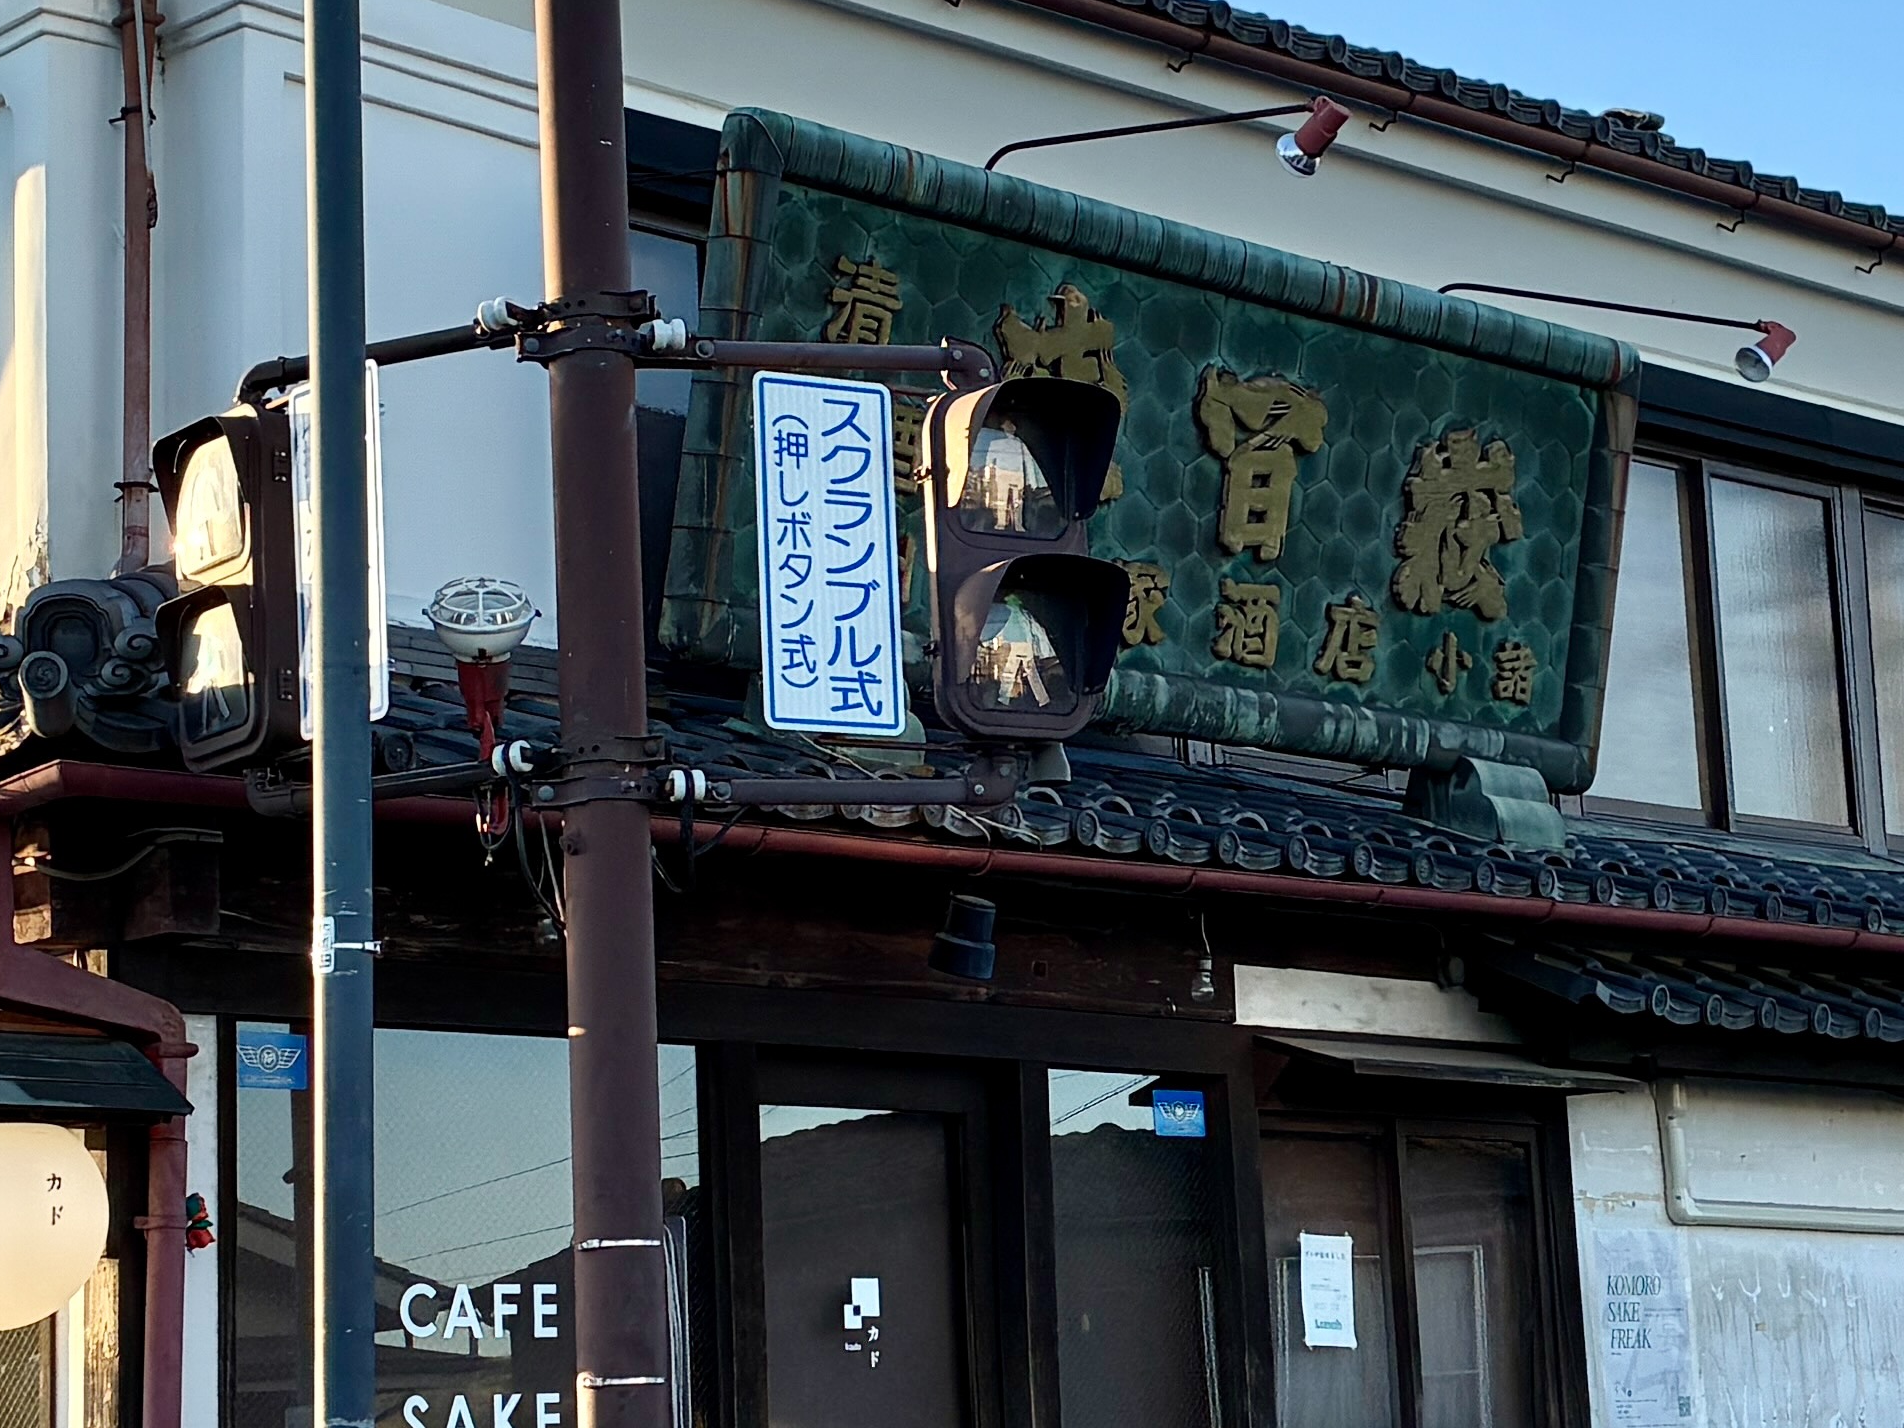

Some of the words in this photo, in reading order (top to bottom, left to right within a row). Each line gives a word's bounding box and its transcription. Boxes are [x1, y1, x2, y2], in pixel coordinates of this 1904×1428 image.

[770, 414, 818, 690] （押しボタン式）
[817, 395, 885, 719] スクランブル式
[46, 1171, 65, 1227] カド
[399, 1281, 558, 1339] CAFE
[1607, 1275, 1662, 1296] KOMORO
[1607, 1301, 1641, 1323] SAKE
[867, 1325, 880, 1368] カド
[1610, 1328, 1652, 1350] FREAK
